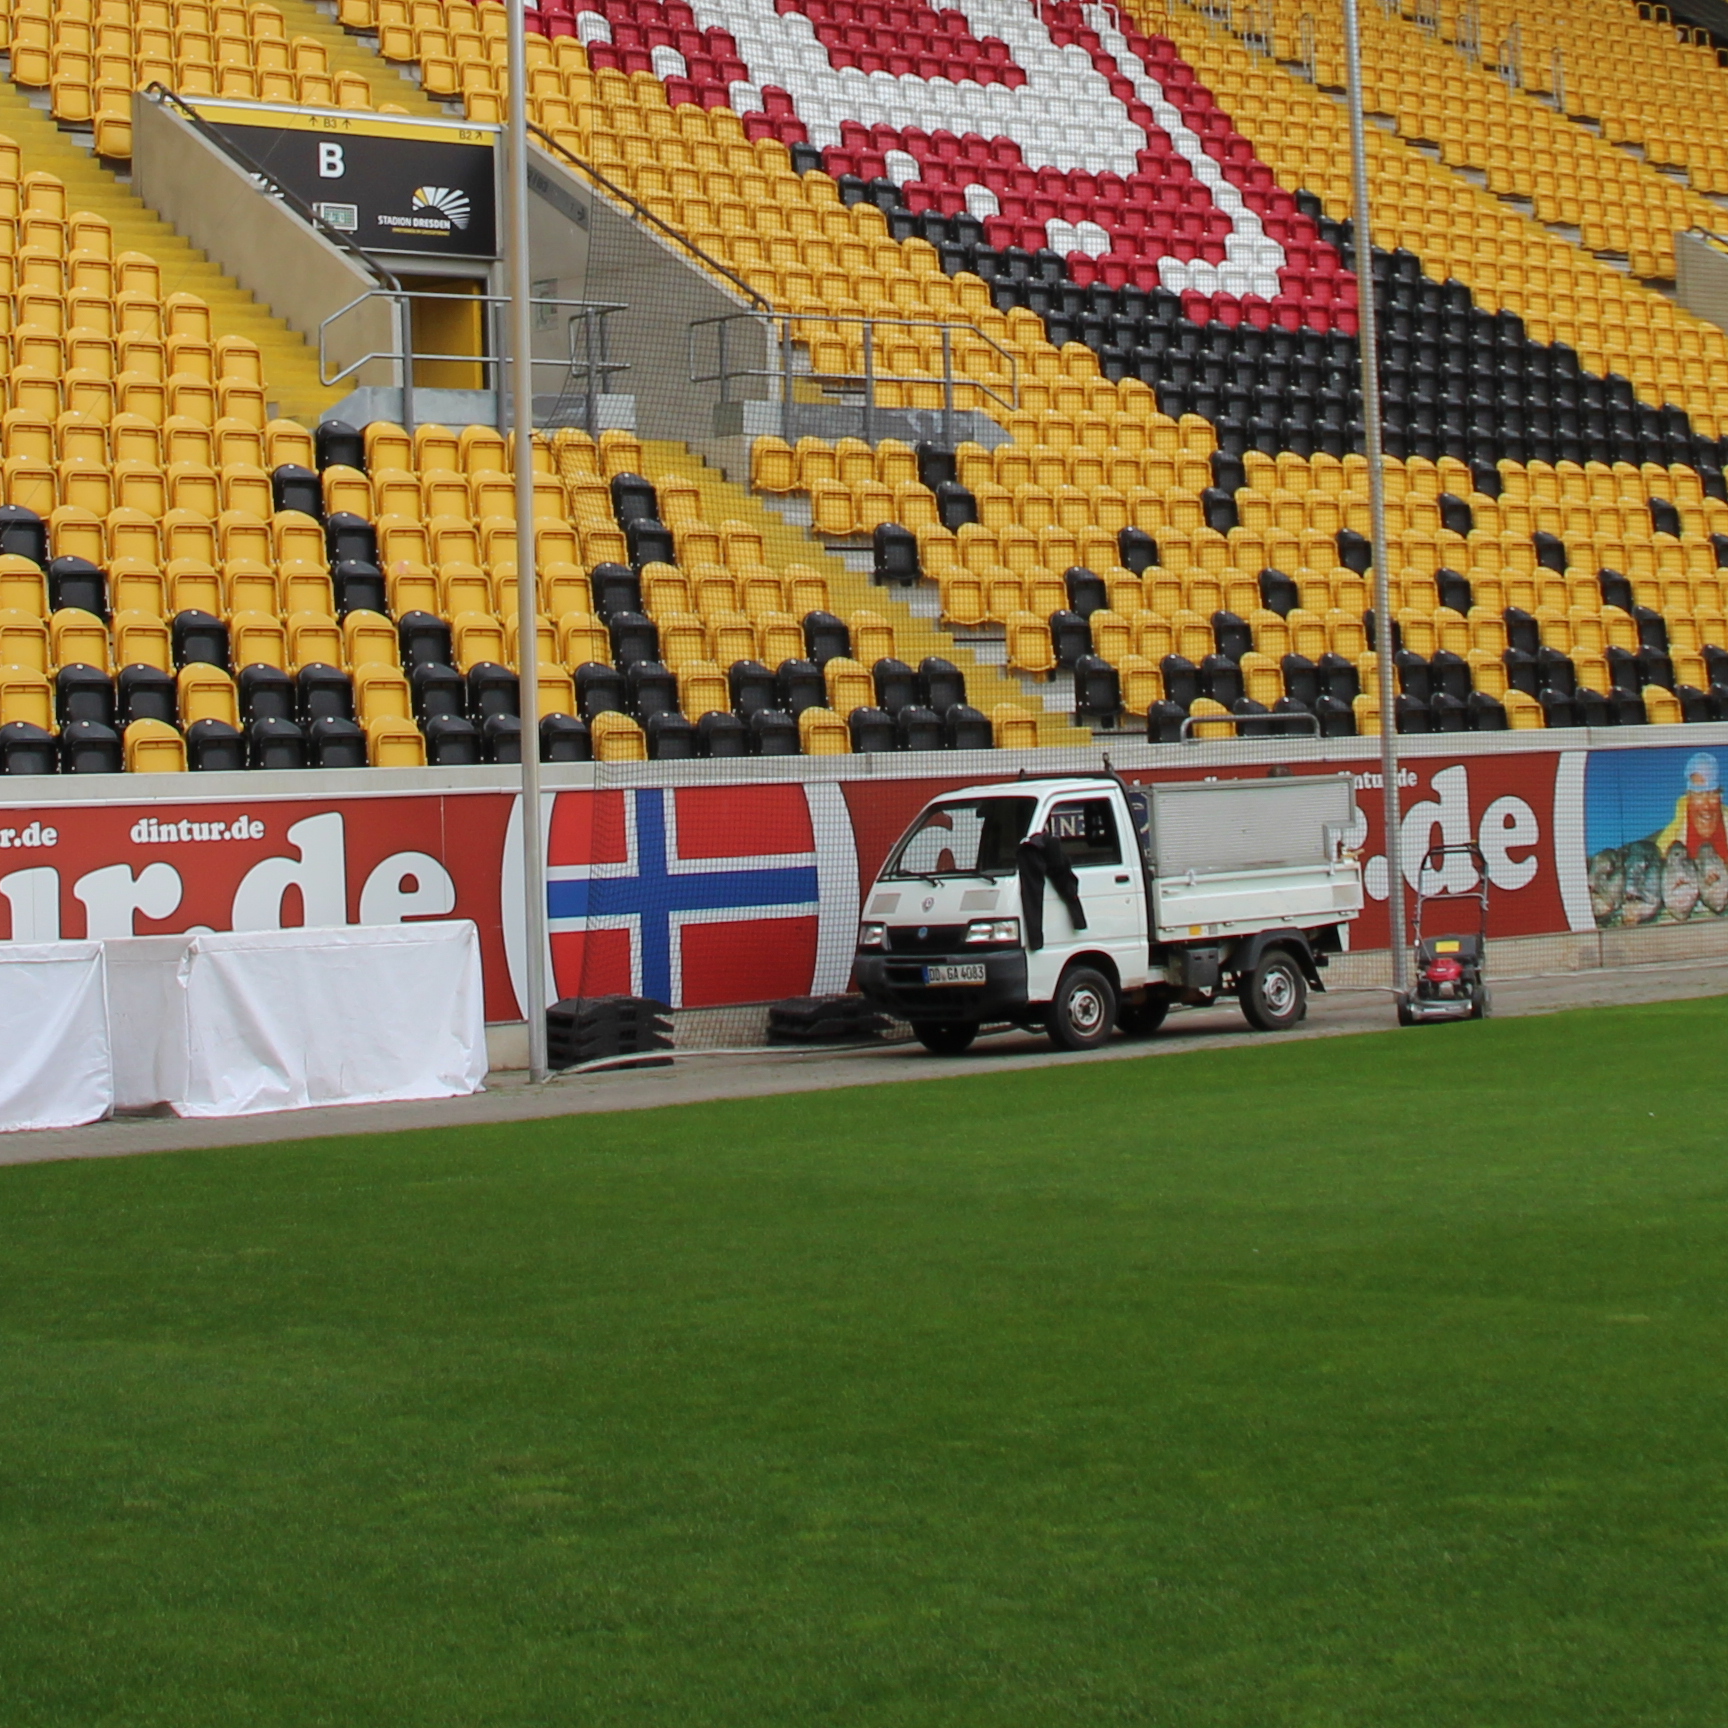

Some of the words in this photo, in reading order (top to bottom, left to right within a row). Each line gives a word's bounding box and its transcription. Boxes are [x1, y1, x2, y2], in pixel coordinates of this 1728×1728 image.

[323, 118, 338, 129] B3
[459, 130, 472, 140] B2
[318, 142, 345, 178] B
[377, 215, 412, 227] STADION
[413, 218, 451, 230] DRESDEN
[130, 815, 265, 845] dintur.de
[928, 968, 940, 981] DD
[947, 967, 959, 980] GA
